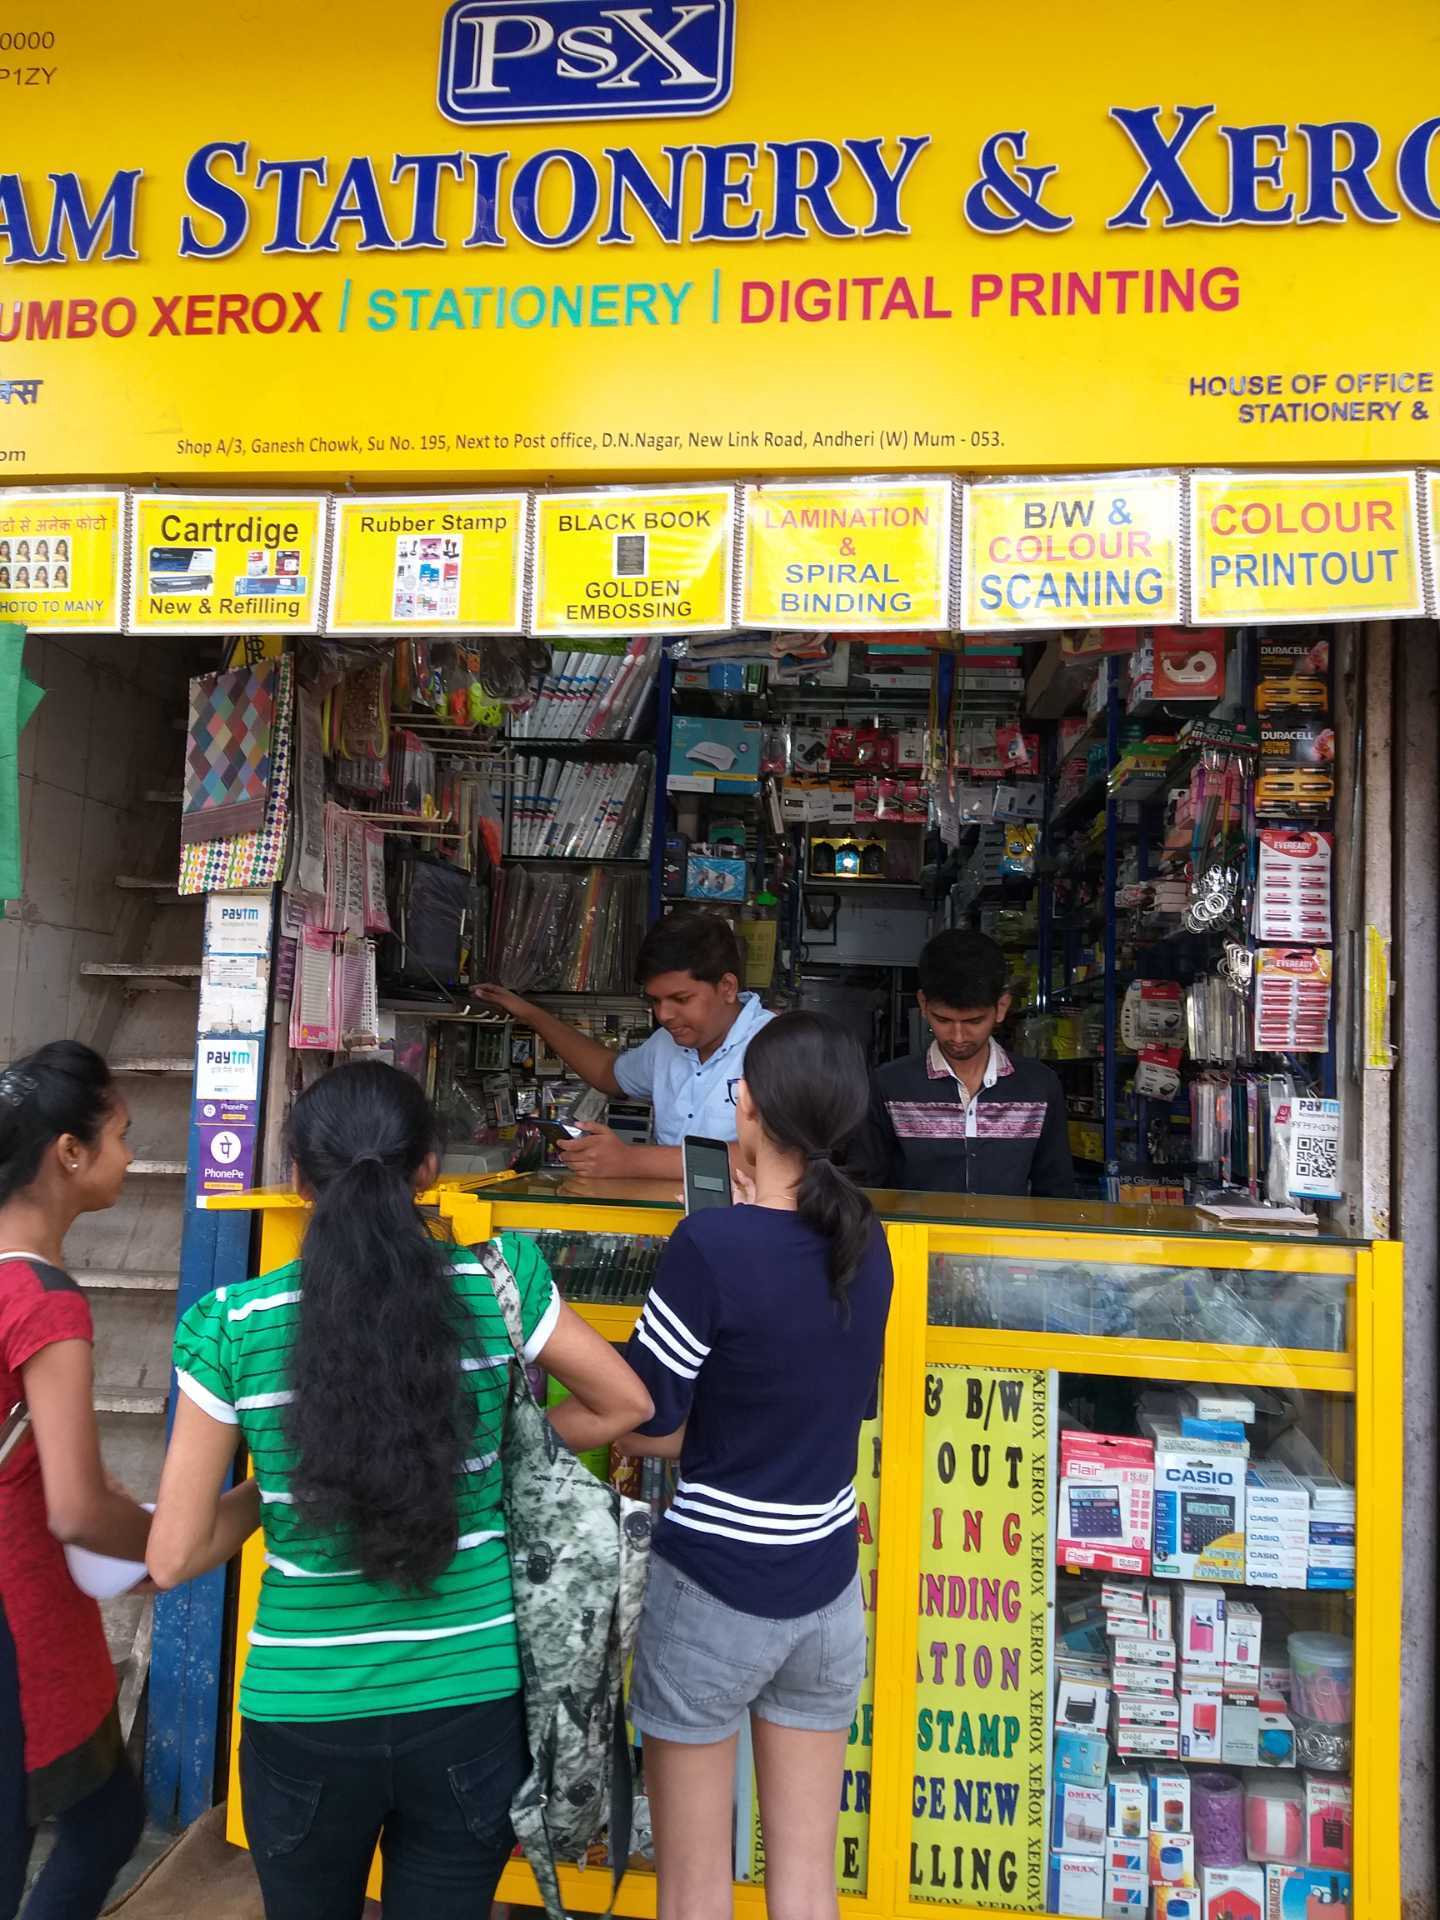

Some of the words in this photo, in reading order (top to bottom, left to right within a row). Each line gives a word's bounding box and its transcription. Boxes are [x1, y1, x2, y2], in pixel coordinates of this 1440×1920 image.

[0, 167, 144, 265] AM
[177, 137, 932, 259] STATIONERY
[964, 129, 1075, 234] &
[0, 296, 138, 342] UMBO
[147, 290, 324, 338] XEROX
[366, 280, 694, 331] STATIONERY
[739, 275, 953, 325] DIGITAL
[970, 266, 1241, 317] PRINTING
[1189, 375, 1283, 397] HOUSE
[1291, 373, 1328, 394] OF
[1336, 372, 1434, 394] OFFICE
[1238, 400, 1402, 424] STATIONERY
[1411, 400, 1430, 420] &
[176, 438, 212, 458] Shop
[216, 437, 246, 457] A/3,
[251, 436, 305, 454] Ganesh
[309, 435, 362, 455] Chowk,
[367, 435, 385, 451] Su
[389, 434, 416, 451] No.
[420, 434, 452, 453] 195,
[455, 433, 491, 450] Next
[493, 434, 509, 449] to
[513, 432, 546, 450] Post
[550, 431, 598, 451] office,
[602, 431, 684, 452] D.N.Nagar,
[688, 431, 723, 448] New
[728, 430, 759, 448] Link
[763, 430, 808, 450] Road,
[812, 430, 875, 448] Andheri
[878, 429, 908, 451] (W)
[913, 431, 955, 448] Mum
[970, 430, 1006, 448] 053.
[360, 514, 436, 533] Rubber
[441, 514, 508, 534] Stamp
[558, 512, 633, 532] BLACK
[643, 510, 711, 529] BOOK
[764, 505, 930, 530] LAMINATION
[1023, 498, 1096, 530] B/W
[1107, 497, 1132, 526] &
[1210, 499, 1396, 537] COLOUR
[160, 514, 300, 549] Cartrdige
[839, 536, 856, 557] &
[988, 529, 1152, 564] COLOUR
[785, 562, 900, 585] SPIRAL
[1210, 548, 1400, 590] PRINTOUT
[584, 579, 681, 600] GOLDEN
[978, 566, 1164, 611] SCANING
[41, 600, 60, 613] TO
[64, 599, 104, 612] MANY
[150, 597, 193, 615] New
[198, 597, 213, 615] &
[219, 597, 300, 617] Refilling
[565, 600, 692, 621] EMBOSSING
[780, 591, 912, 613] BINDING
[1260, 646, 1311, 656] DURACELL
[1261, 731, 1314, 741] DURACELL
[1273, 840, 1313, 850] EVEREADY
[1275, 959, 1313, 969] EVEREADY
[203, 1167, 245, 1180] PhonePe
[966, 1377, 1024, 1431] B/W
[937, 1440, 1024, 1489] OUT
[1031, 1452, 1046, 1518] XEROX
[1166, 1468, 1234, 1486] CASIO
[1252, 1495, 1280, 1504] CASIO
[1249, 1514, 1279, 1523] CASIO
[1249, 1534, 1280, 1543] CASIO
[1031, 1531, 1046, 1597] XEROX
[1249, 1551, 1280, 1561] CASIO
[1249, 1570, 1279, 1580] CASIO
[1029, 1610, 1045, 1676] XEROX
[917, 1707, 1021, 1759] STAMP
[1029, 1689, 1044, 1755] XEROX
[953, 1778, 1020, 1827] NEW
[1067, 1790, 1103, 1803] OMAX
[1027, 1837, 1043, 1902] XEROX
[1063, 1862, 1099, 1877] OMAX
